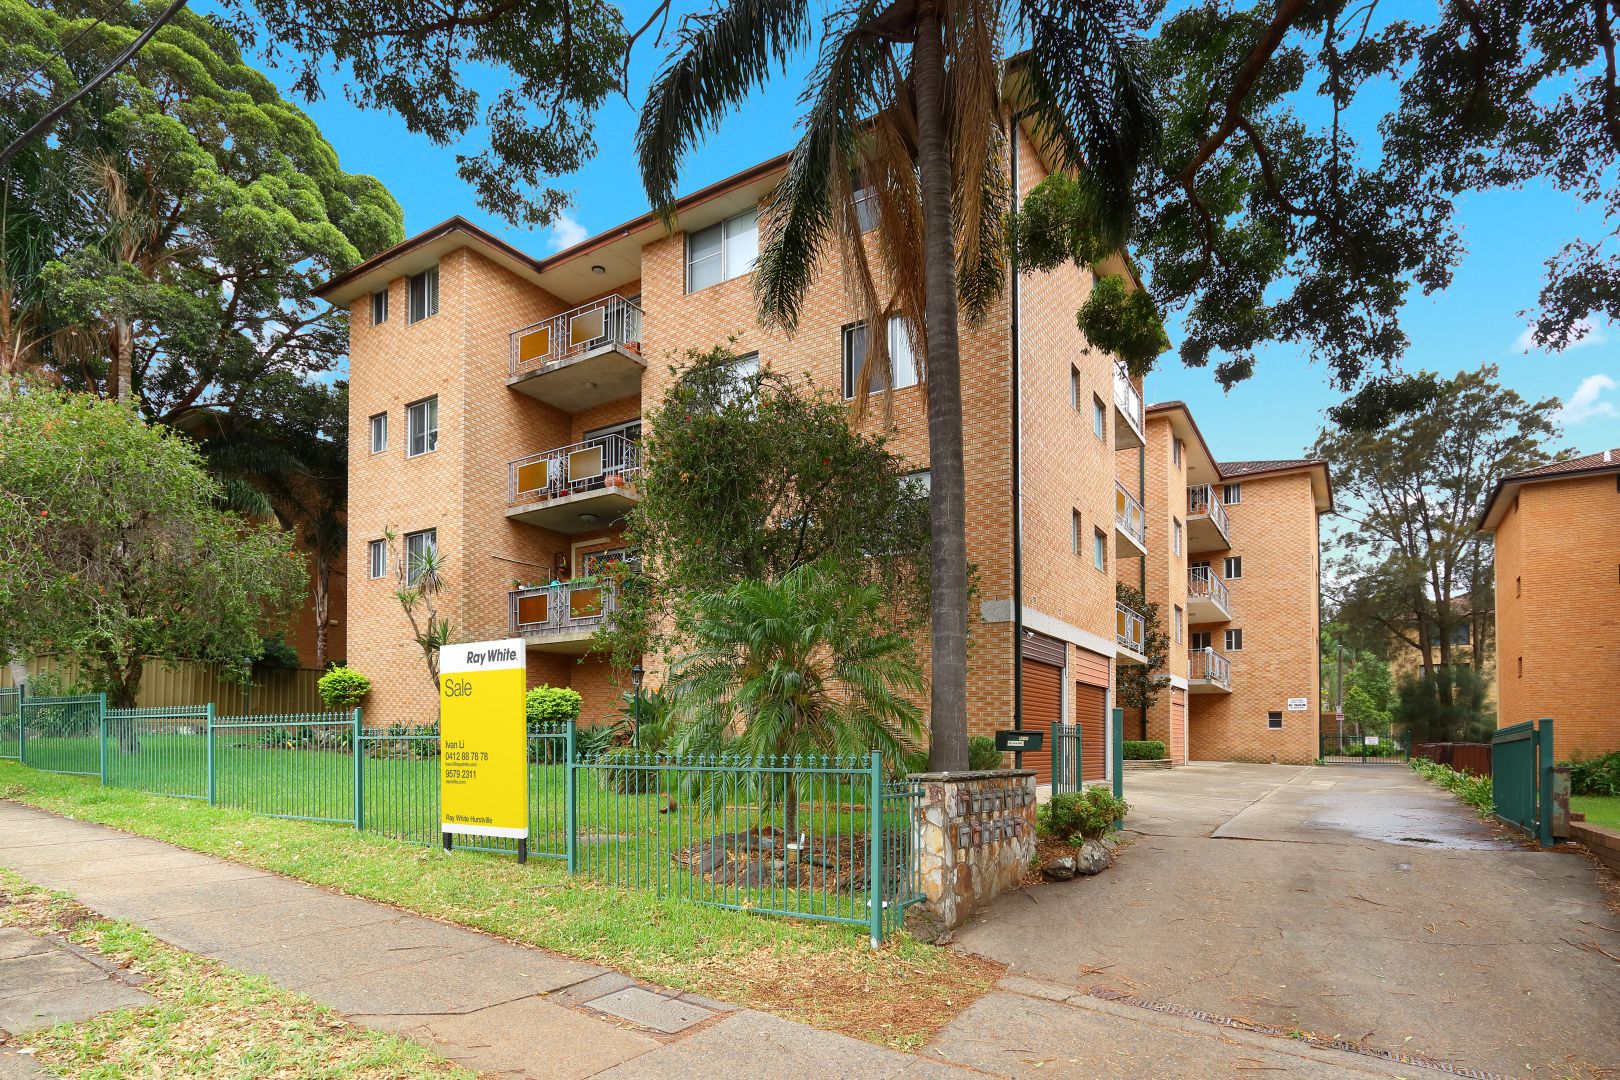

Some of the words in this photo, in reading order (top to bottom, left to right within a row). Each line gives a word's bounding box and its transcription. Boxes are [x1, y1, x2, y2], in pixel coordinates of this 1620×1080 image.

[467, 651, 486, 666] Ray
[445, 678, 472, 697] Sale
[445, 740, 458, 749] Ivan
[459, 740, 465, 749] Li
[445, 752, 460, 761] 0412
[461, 752, 470, 761] 88
[471, 752, 479, 761] 78
[480, 752, 489, 761] 78
[445, 769, 460, 778] 9579
[461, 770, 476, 779] 2311
[445, 814, 455, 822] Ray
[456, 814, 469, 822] White
[470, 816, 493, 824] Hurstville
